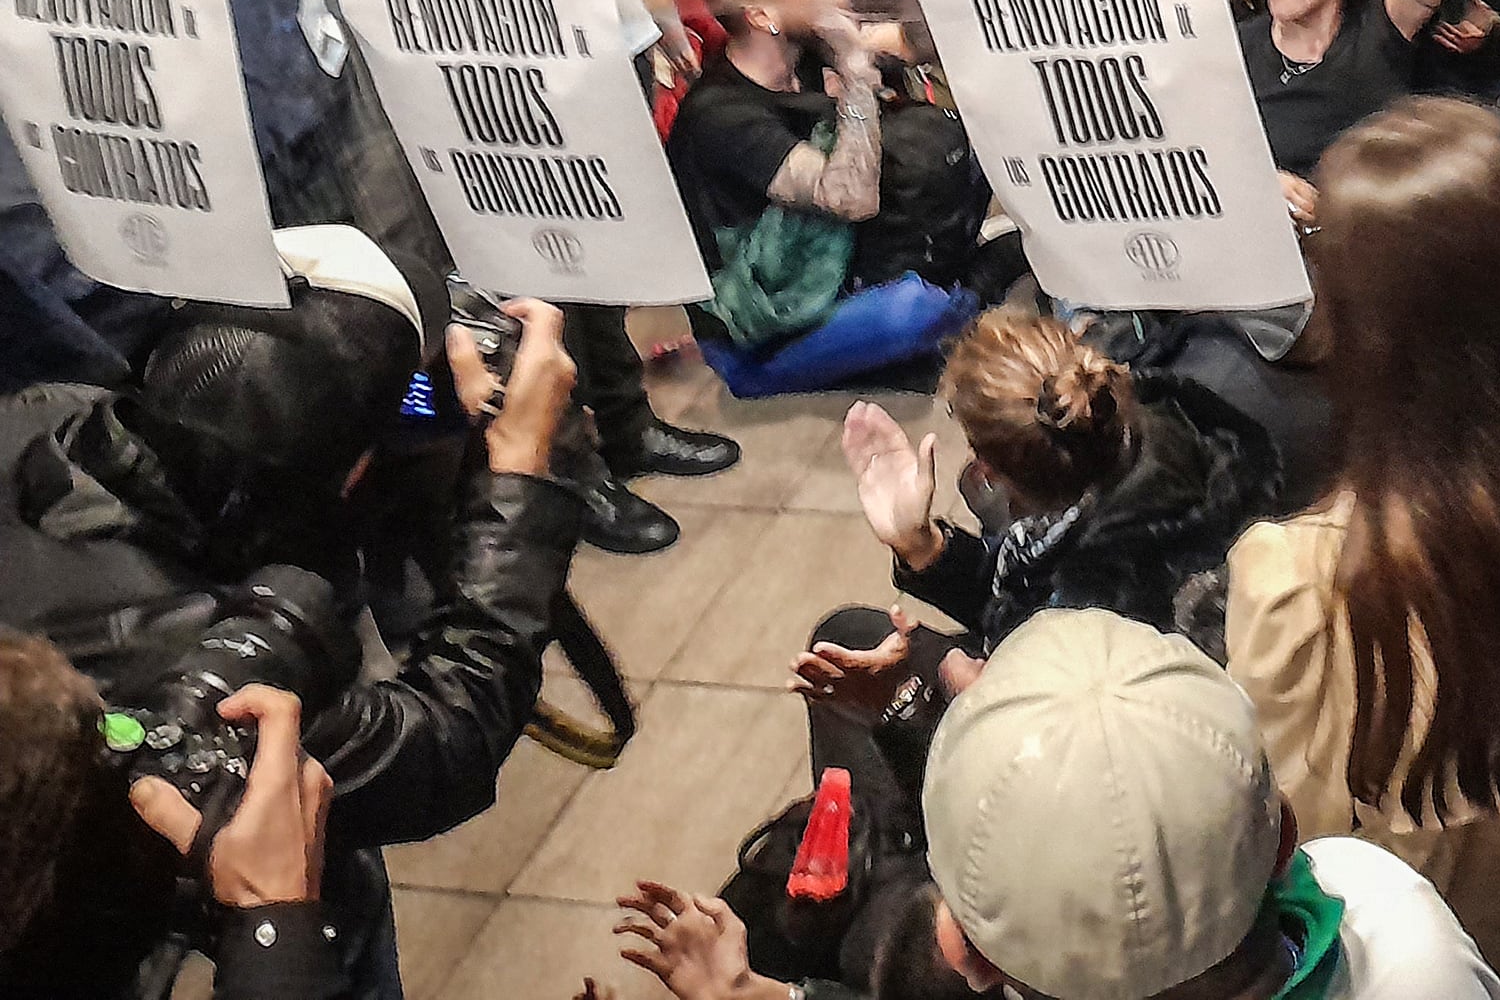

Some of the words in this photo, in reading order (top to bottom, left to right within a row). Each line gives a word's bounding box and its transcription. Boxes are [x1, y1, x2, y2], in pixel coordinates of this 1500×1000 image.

[436, 62, 566, 148] TODOS
[1030, 53, 1165, 146] TODOS
[448, 148, 625, 222] CONTRATOS
[1038, 147, 1225, 224] CONTRATOS
